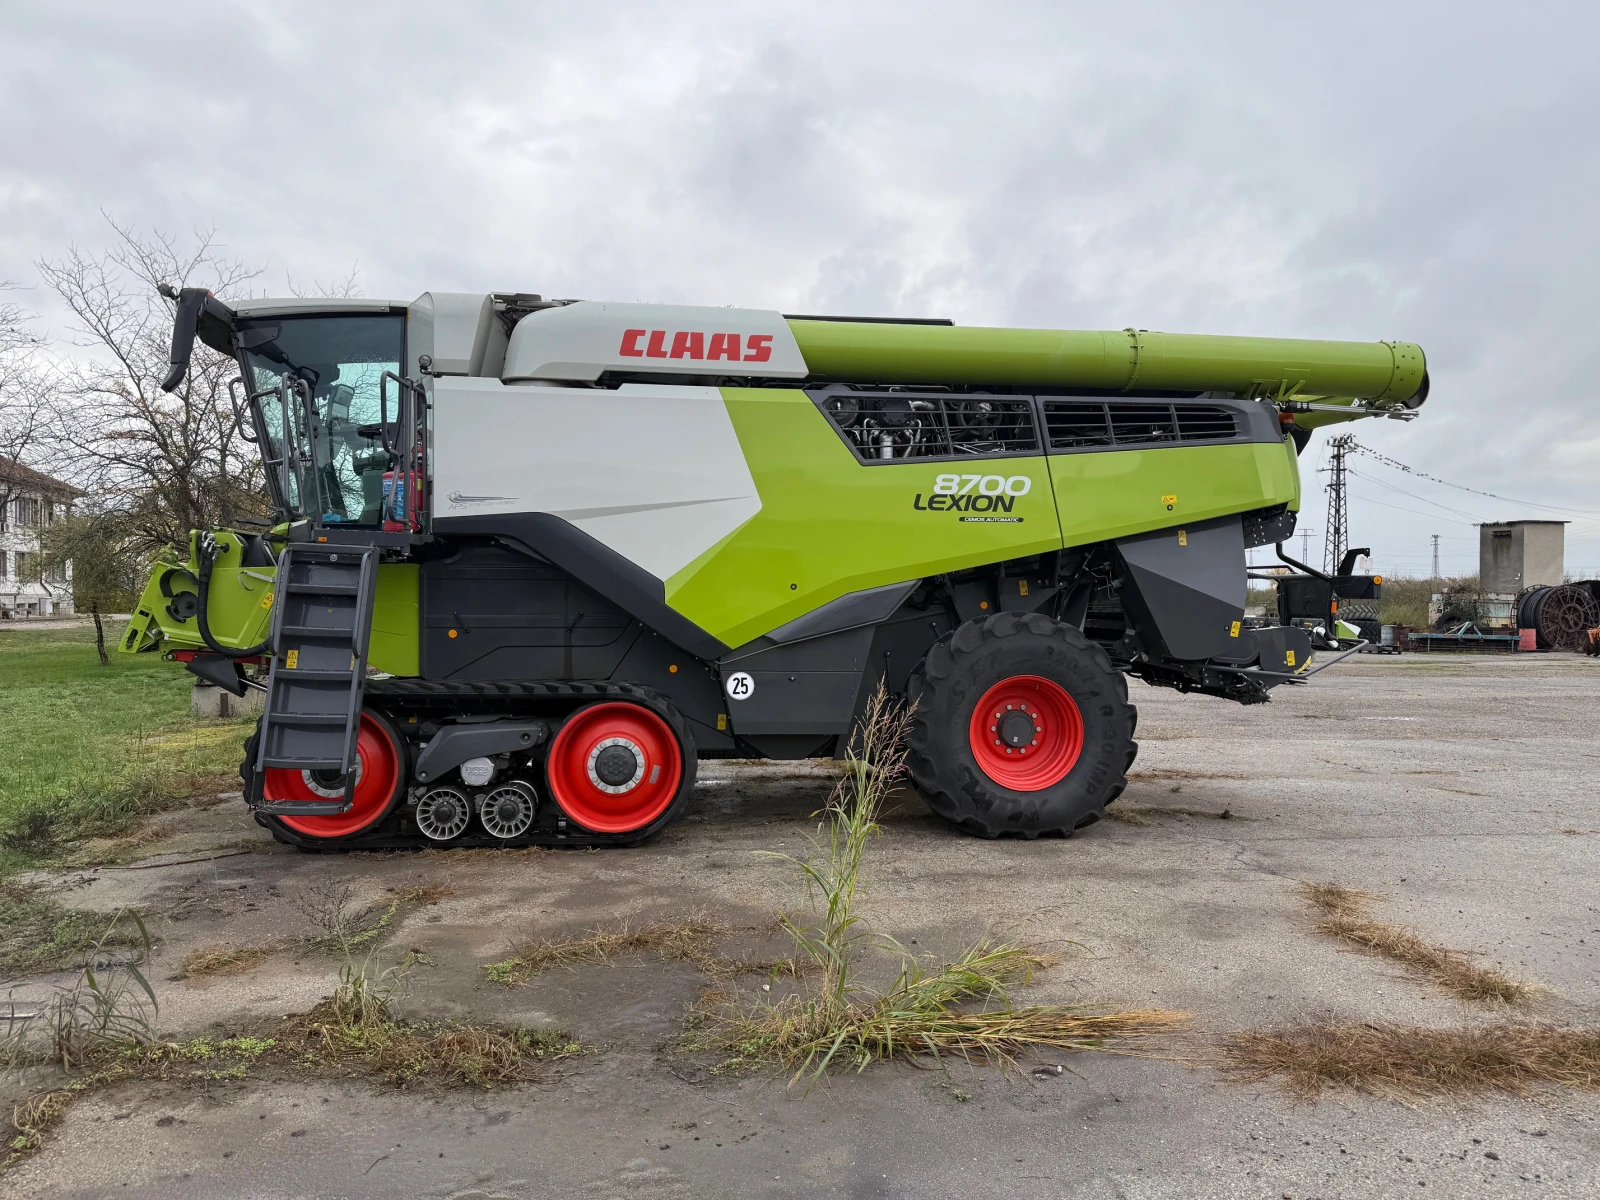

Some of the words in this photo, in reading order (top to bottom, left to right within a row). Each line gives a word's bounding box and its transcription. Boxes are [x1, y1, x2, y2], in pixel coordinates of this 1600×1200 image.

[619, 329, 773, 362] CLAAS
[933, 474, 1031, 496] 8700
[914, 494, 1015, 512] LEXION
[733, 677, 748, 694] 25
